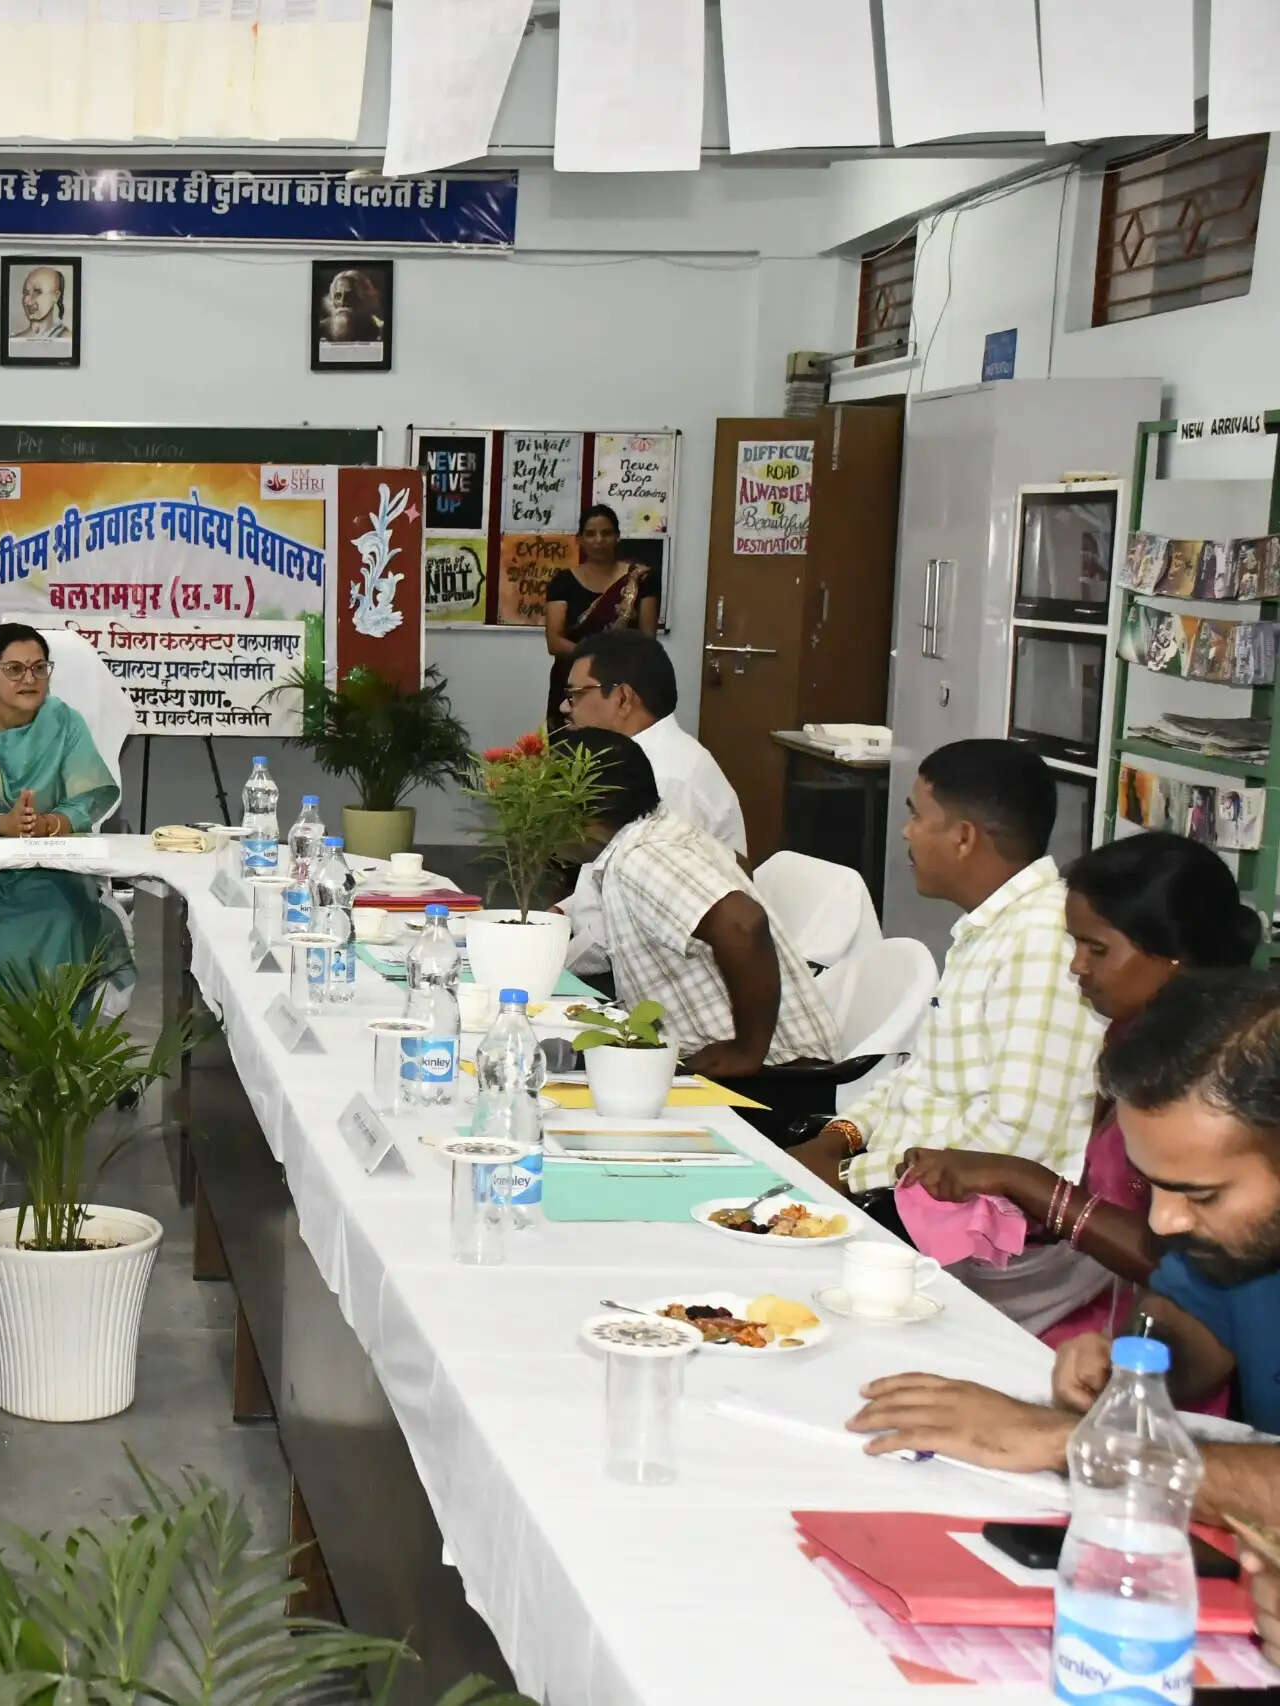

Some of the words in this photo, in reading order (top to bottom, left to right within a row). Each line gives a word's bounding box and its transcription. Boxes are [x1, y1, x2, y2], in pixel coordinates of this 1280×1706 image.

[106, 169, 180, 203] विचार
[183, 169, 212, 204] ही
[211, 171, 292, 215] दुनिया
[1181, 422, 1204, 440] NEW
[1210, 414, 1260, 436] ARRIVALS
[427, 451, 476, 472] NEVER
[514, 459, 558, 484] Right
[766, 464, 799, 480] ROAD
[290, 478, 325, 490] SHRI
[431, 472, 471, 493] GIVE
[621, 470, 652, 487] Stop
[436, 494, 462, 513] UP
[607, 483, 667, 504] Exploring
[512, 500, 553, 525] Easy
[770, 501, 784, 515] TO
[53, 508, 82, 563] श्री
[85, 502, 156, 552] जवाहर
[160, 490, 234, 555] नवोदय
[237, 506, 325, 586] विद्यालय
[426, 570, 472, 594] NOT
[49, 583, 163, 618] बलरामपुर
[170, 575, 255, 619] (छ.ग.)
[108, 621, 158, 650] जिला
[217, 655, 275, 681] समिति
[129, 687, 186, 708] सदस्य
[216, 705, 272, 728] समिति
[422, 1056, 451, 1067] kinley
